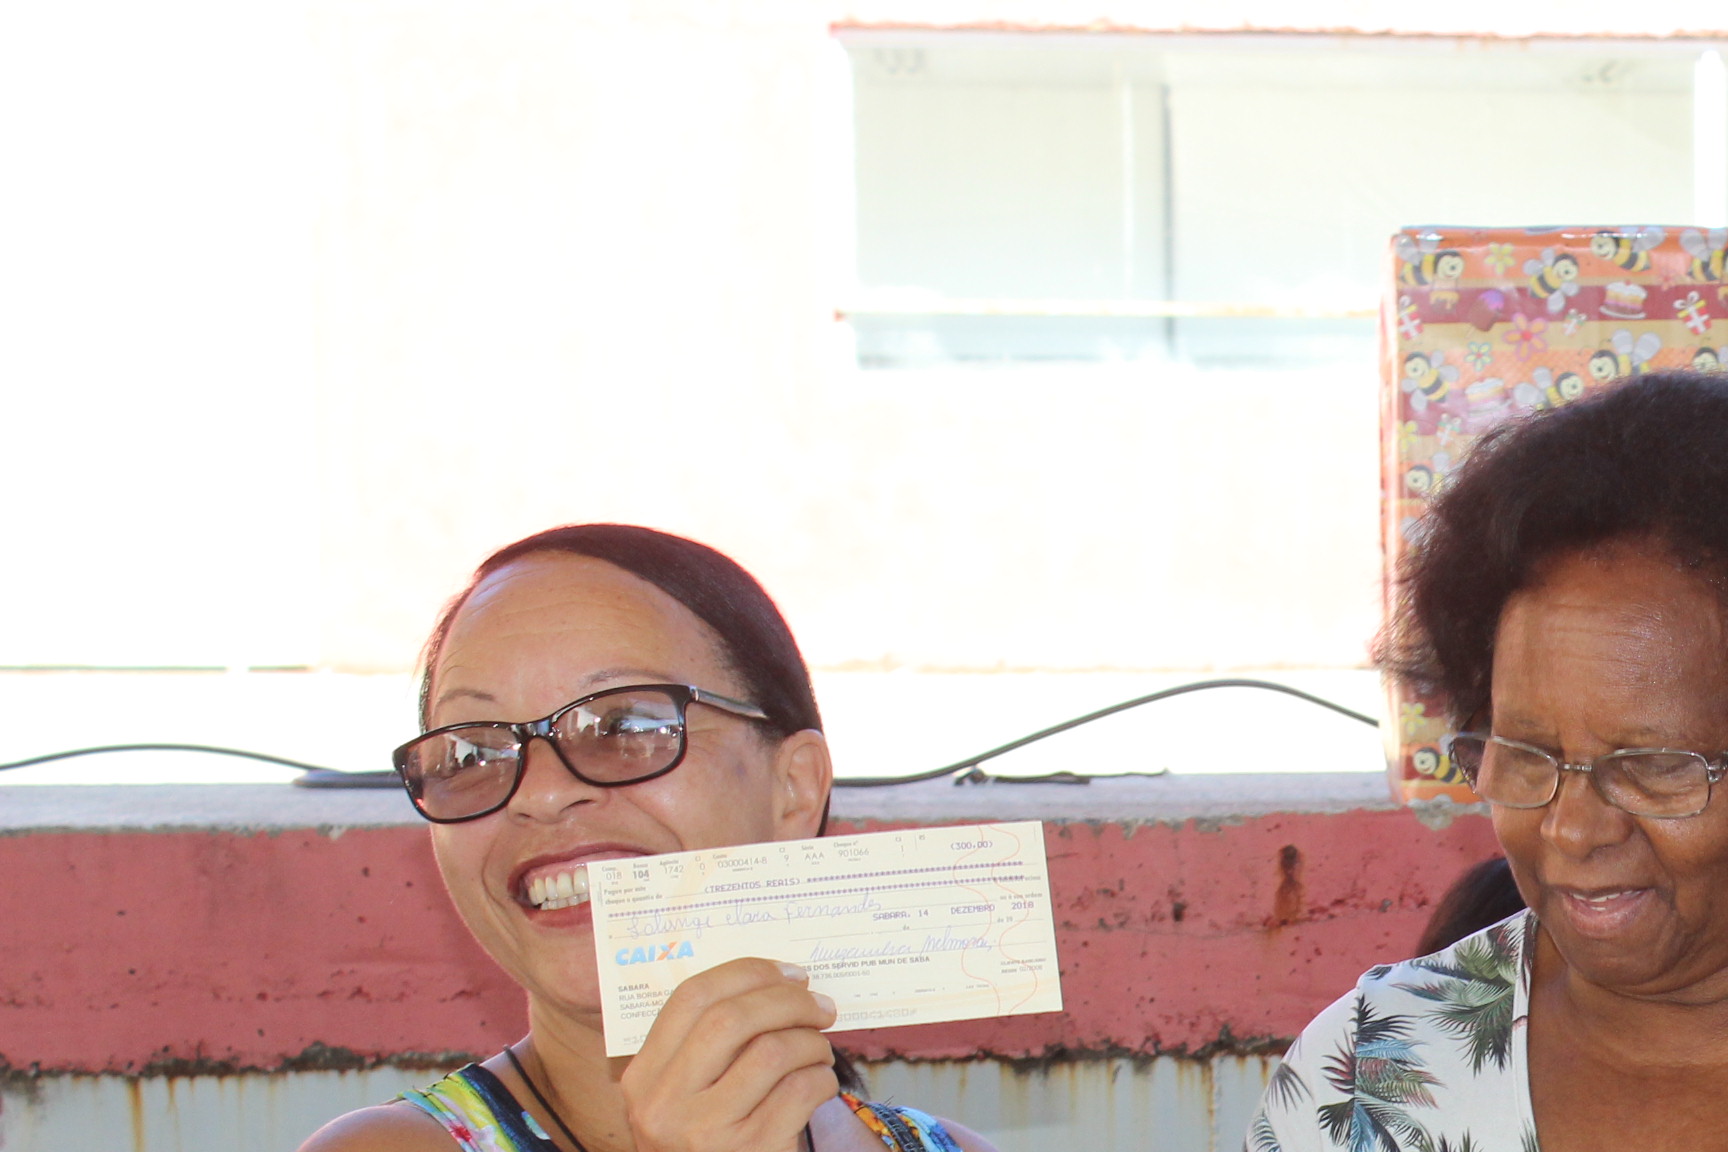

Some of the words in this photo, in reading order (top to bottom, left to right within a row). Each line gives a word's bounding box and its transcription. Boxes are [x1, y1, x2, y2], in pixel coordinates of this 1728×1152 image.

[805, 852, 825, 860] AAA
[838, 848, 870, 858] 901066
[718, 856, 768, 869] 03000414-8
[664, 865, 685, 874] 1742
[606, 872, 622, 881] 018
[632, 870, 650, 879] 104
[705, 881, 762, 894] (TREZENTOS
[766, 878, 801, 888] REAIS)
[918, 908, 929, 918] 14
[951, 904, 996, 916] DEZEMBRO
[1012, 901, 1035, 910] 2018
[616, 940, 694, 966] CAIXA
[832, 962, 860, 970] SERVID
[618, 983, 650, 992] SABARA
[636, 992, 663, 1000] BORBA
